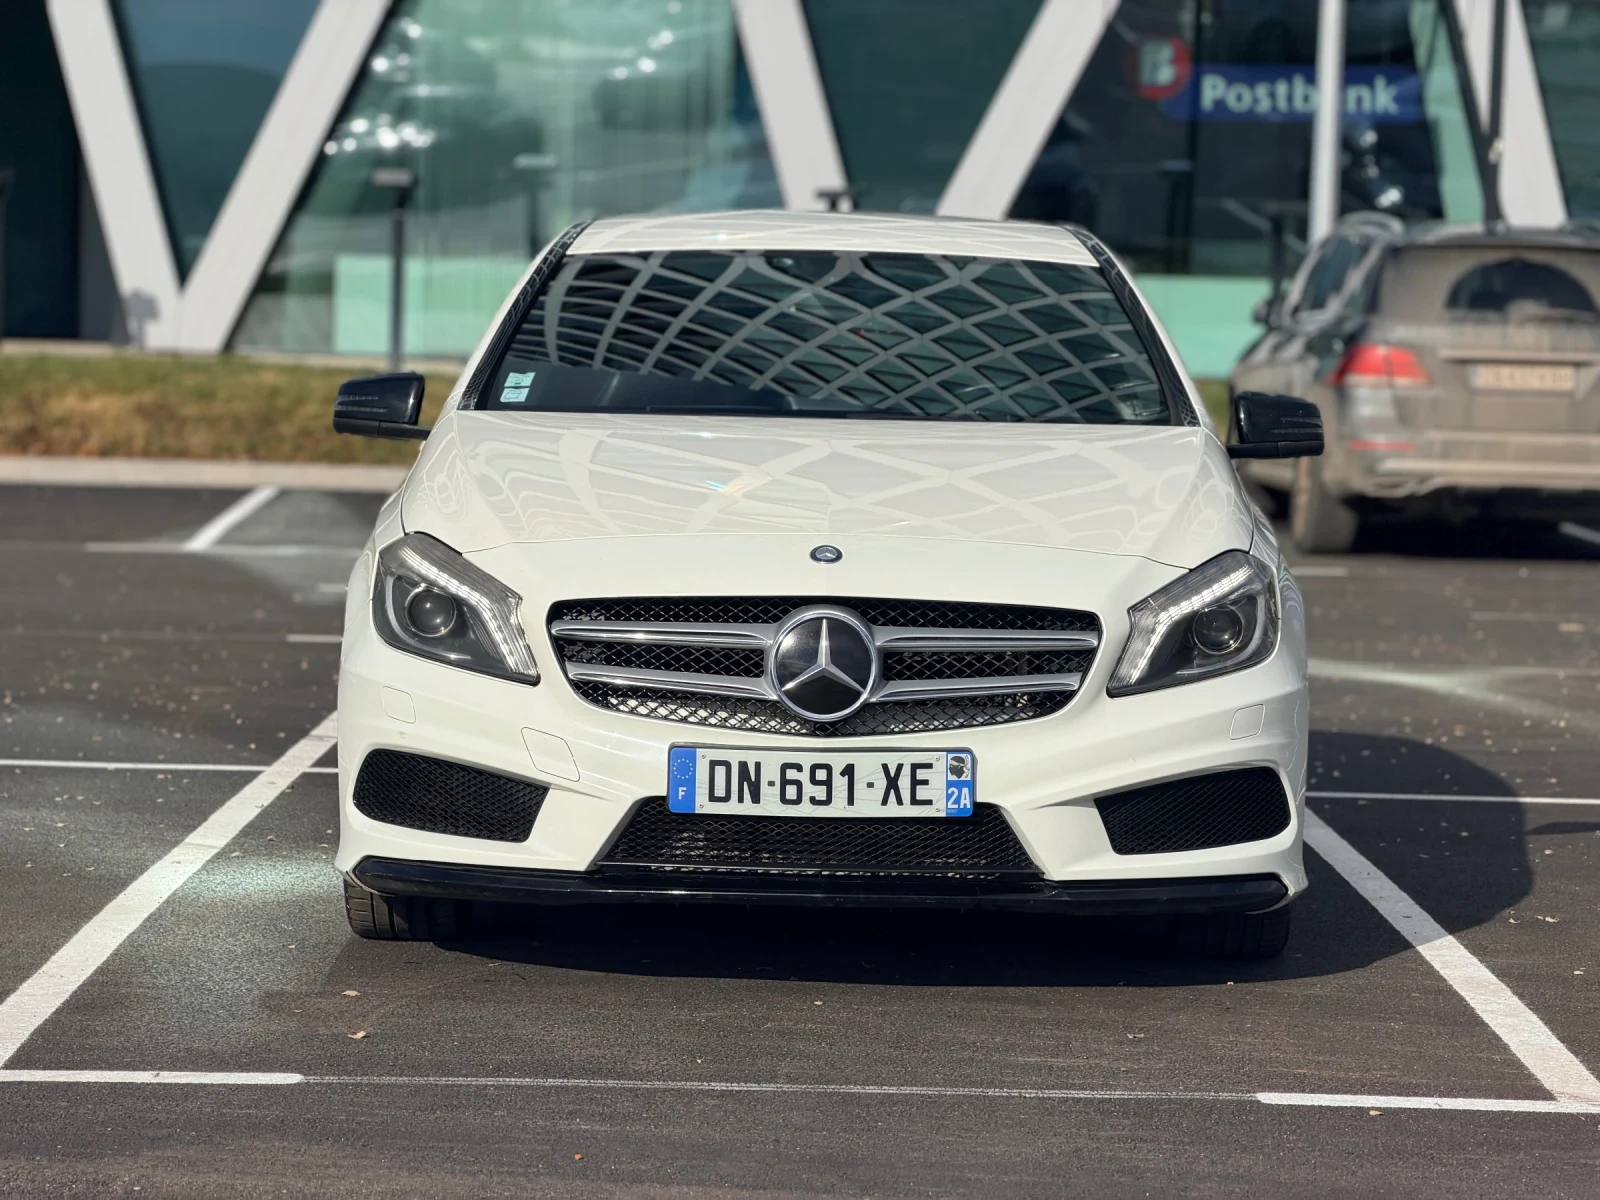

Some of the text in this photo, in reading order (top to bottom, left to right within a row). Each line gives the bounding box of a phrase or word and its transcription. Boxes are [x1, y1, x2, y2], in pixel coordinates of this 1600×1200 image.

[1201, 72, 1399, 115] Postbnk
[678, 787, 687, 800] F
[708, 759, 934, 807] DN-691-XE
[947, 787, 971, 809] 2A
